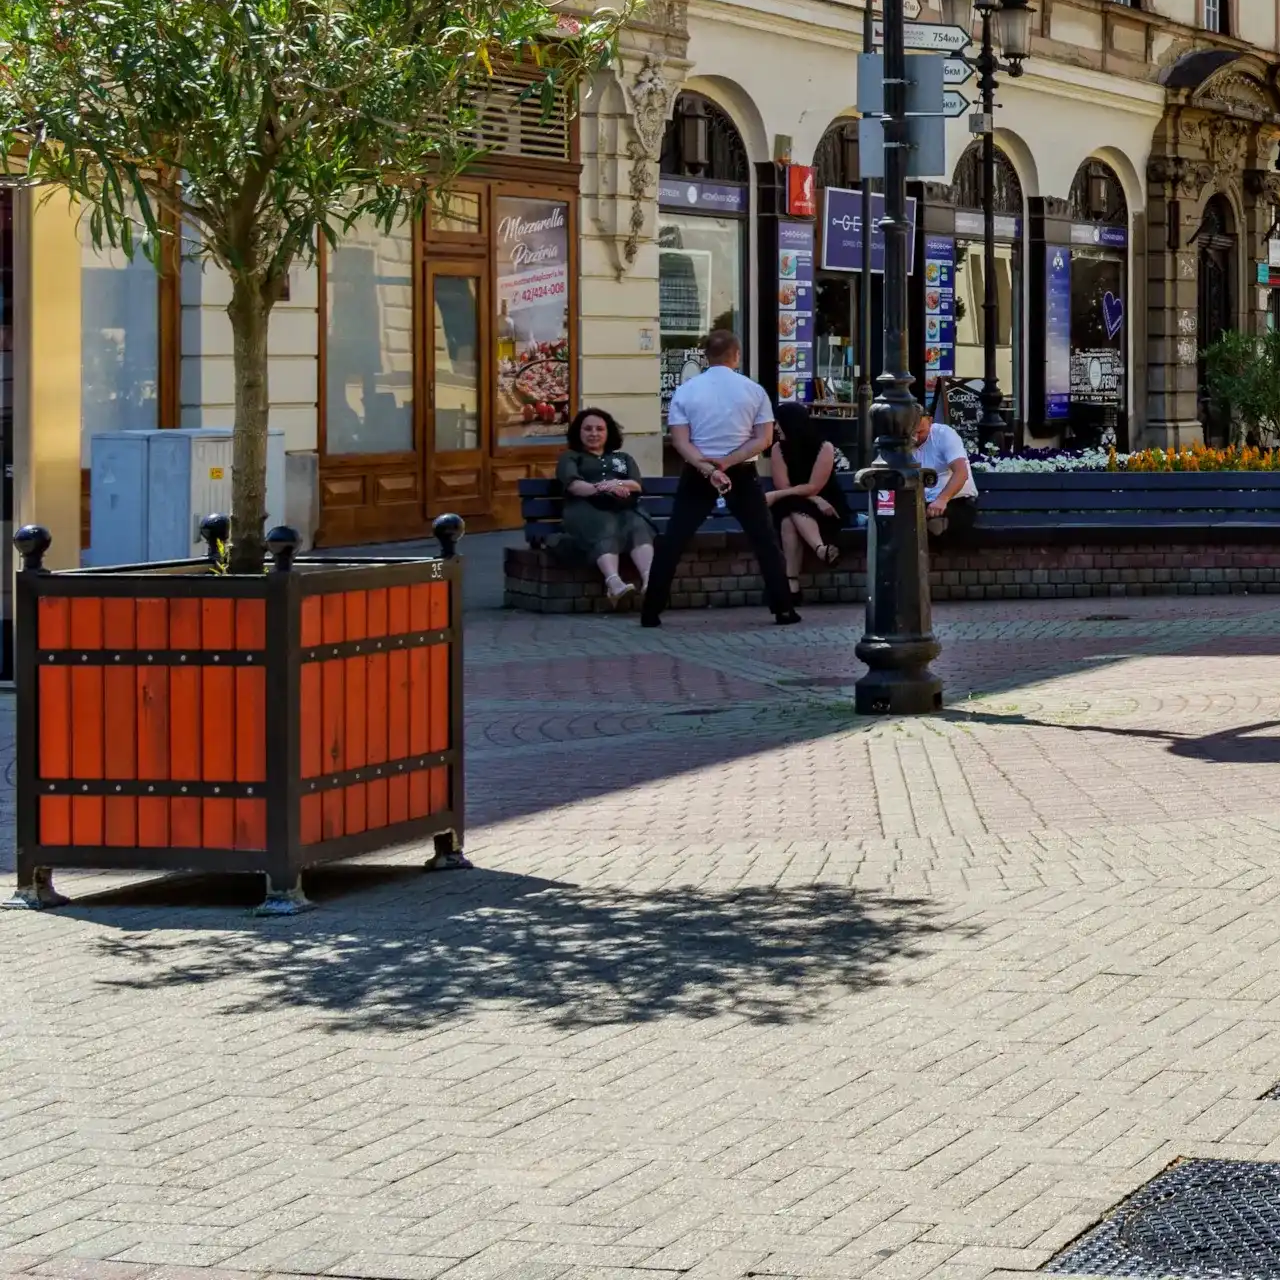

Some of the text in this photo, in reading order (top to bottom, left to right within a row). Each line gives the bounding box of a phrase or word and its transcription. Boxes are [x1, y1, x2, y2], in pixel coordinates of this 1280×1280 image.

[932, 32, 960, 43] 754KM
[497, 208, 564, 244] Mozzarella
[510, 242, 559, 273] Pizzéria
